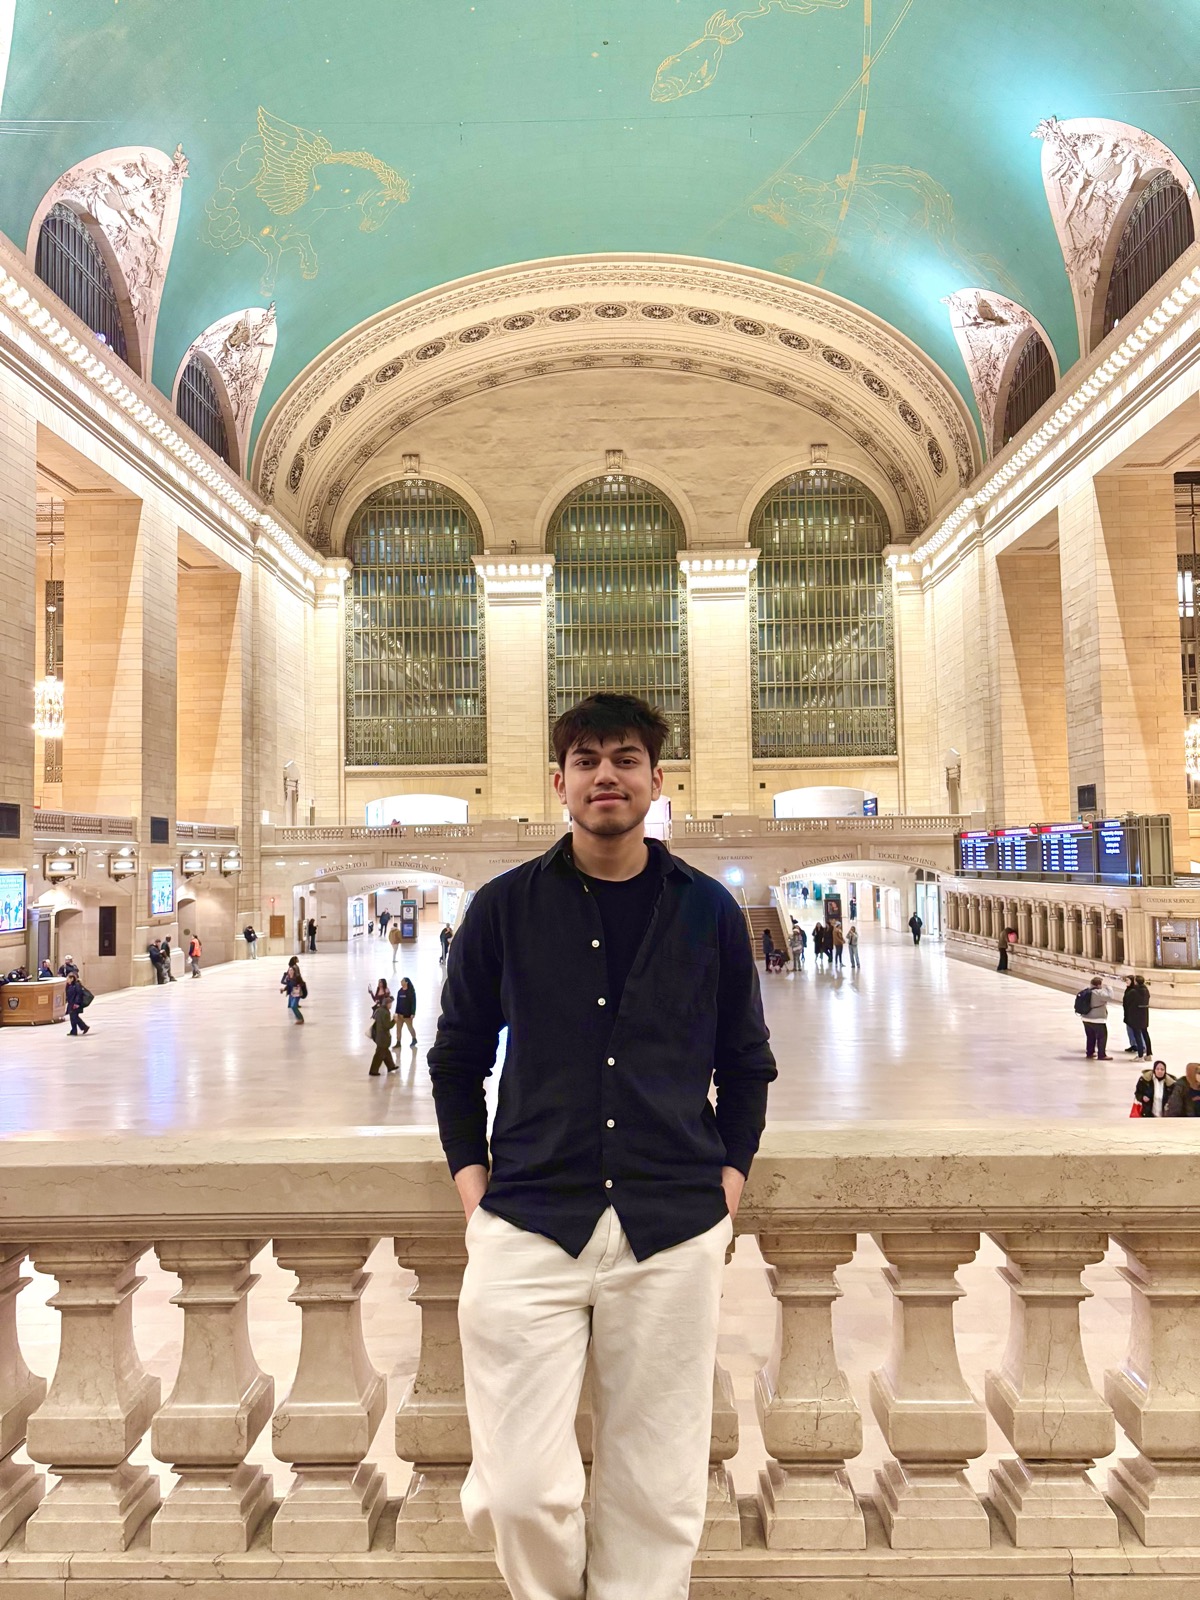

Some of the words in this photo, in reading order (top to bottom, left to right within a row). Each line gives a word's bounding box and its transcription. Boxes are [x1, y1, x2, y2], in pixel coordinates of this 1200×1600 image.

[390, 860, 429, 870] LEXINGTON
[801, 854, 840, 867] LEXINGTON
[878, 852, 900, 860] TICKET
[903, 855, 937, 867] MACHINES
[320, 865, 344, 874] TRACKS
